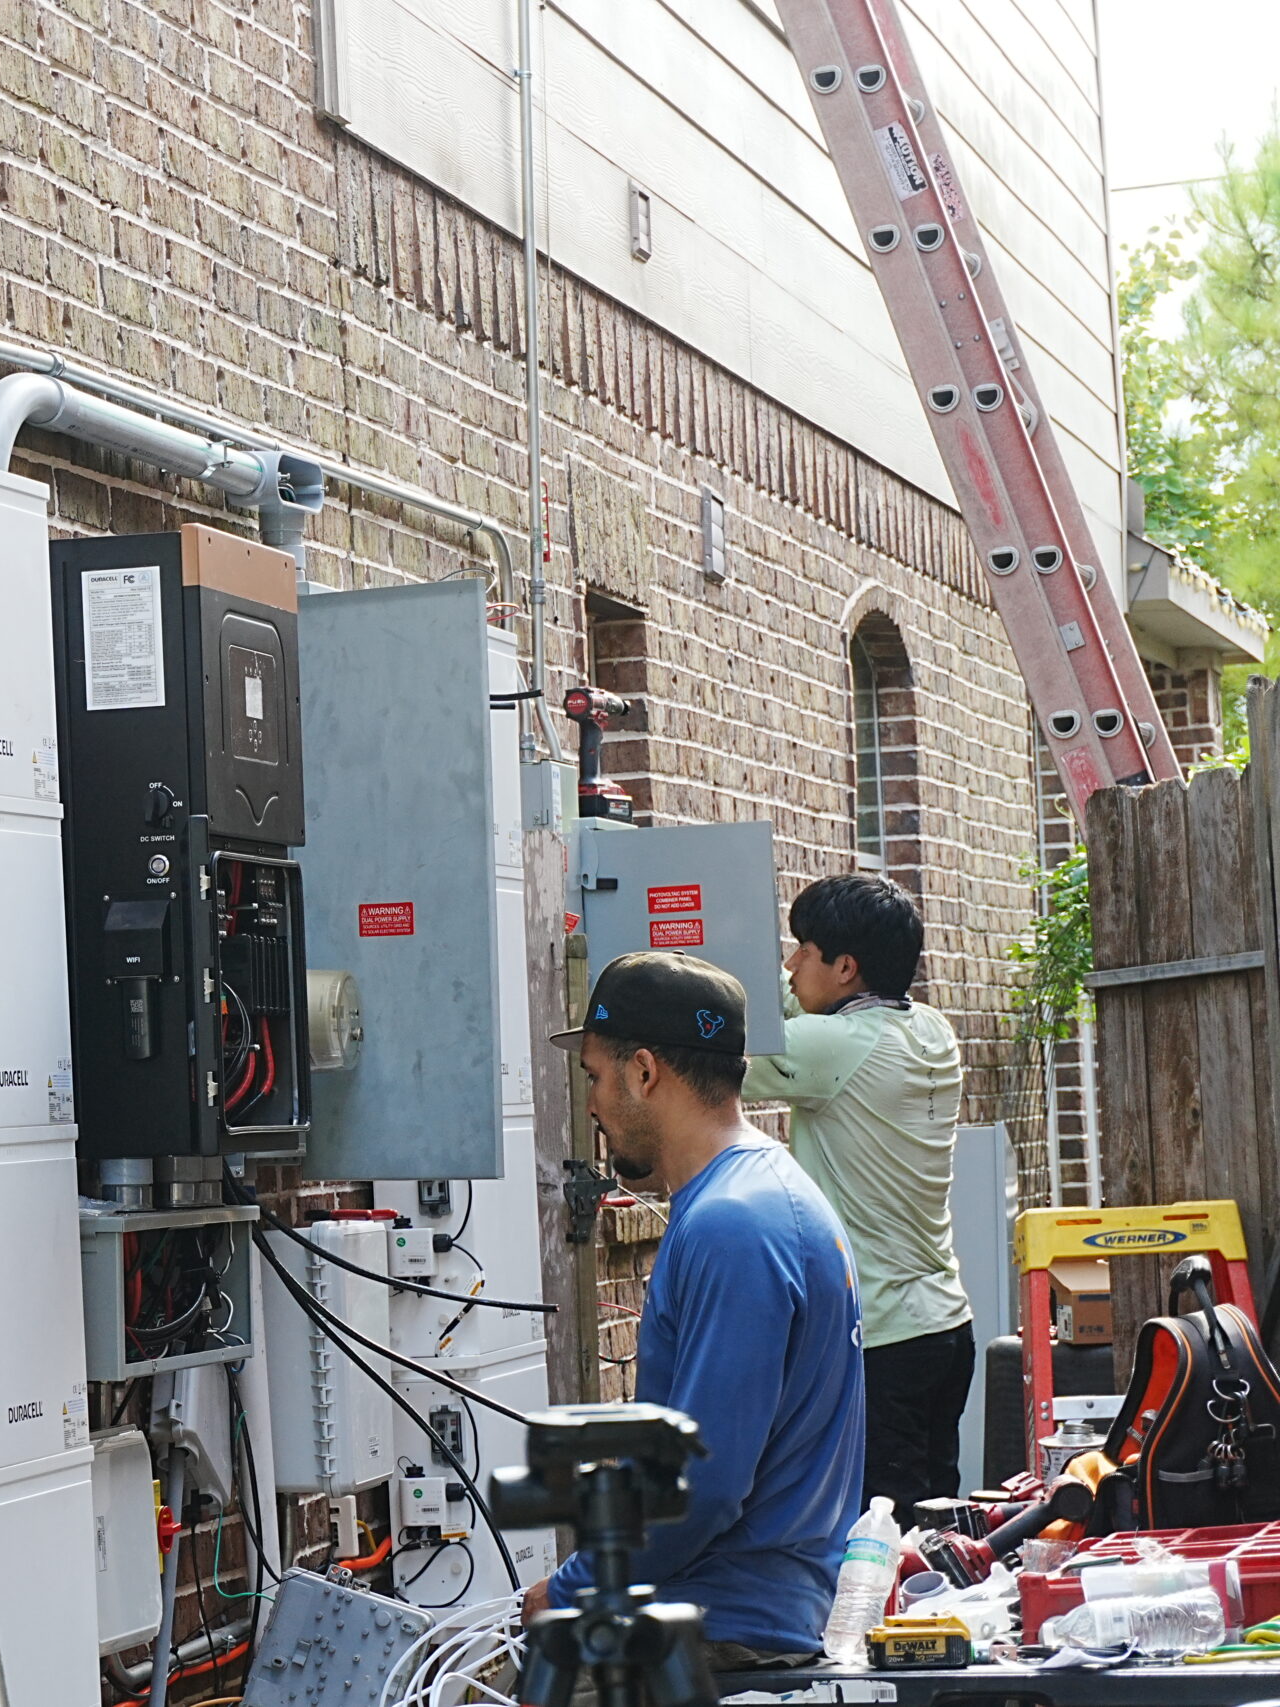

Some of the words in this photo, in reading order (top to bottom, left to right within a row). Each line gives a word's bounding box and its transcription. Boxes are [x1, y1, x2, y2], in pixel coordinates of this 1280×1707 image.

[368, 906, 403, 915] WARNING
[1104, 1234, 1167, 1245] WERNER
[8, 1401, 43, 1424] DURACELL
